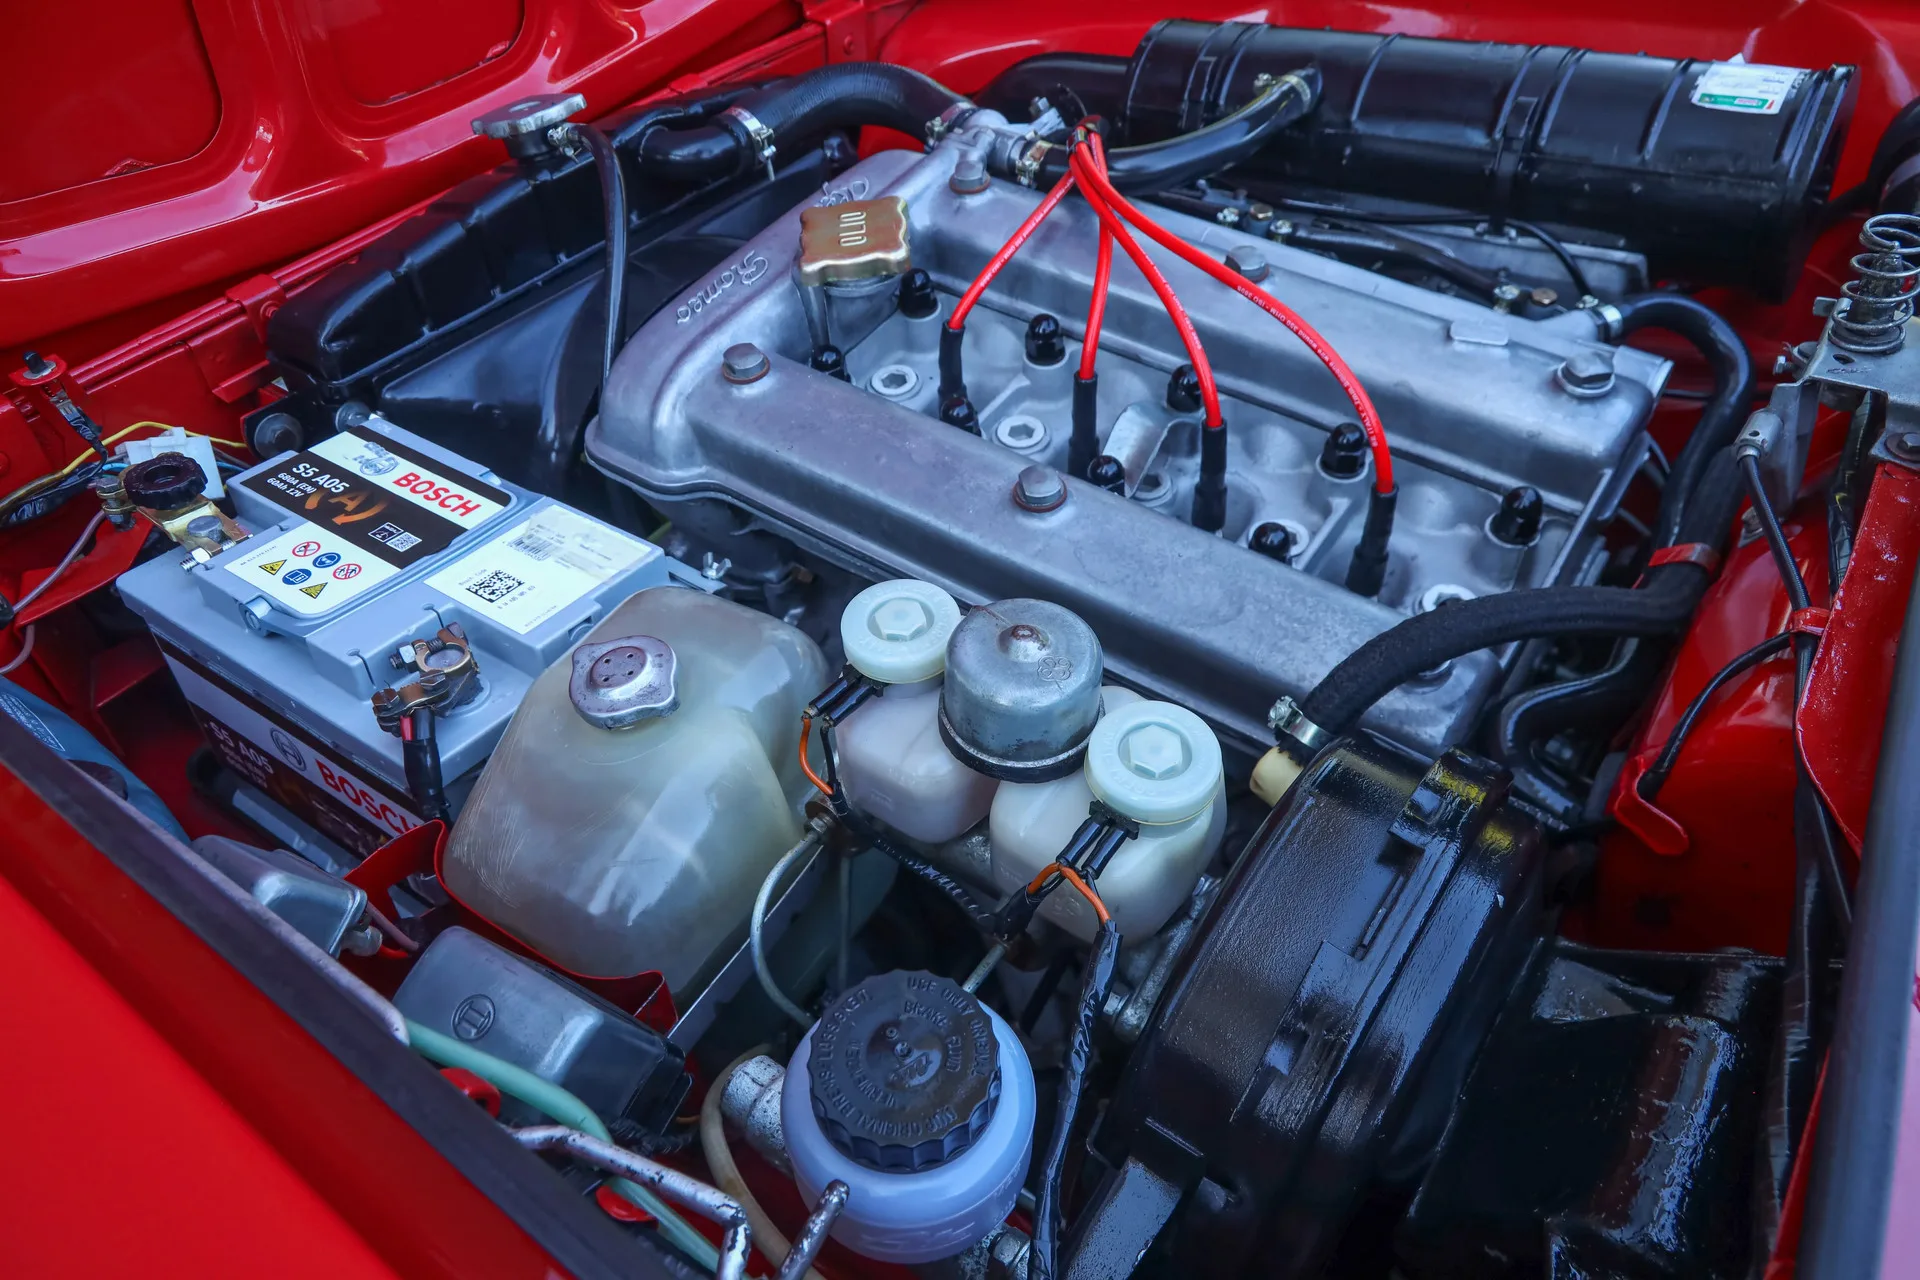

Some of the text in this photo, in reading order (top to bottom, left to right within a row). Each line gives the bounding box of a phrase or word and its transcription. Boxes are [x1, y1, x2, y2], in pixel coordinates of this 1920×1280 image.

[677, 251, 768, 325] Romeo
[1252, 295, 1266, 307] ISO
[1269, 307, 1286, 322] OHM
[266, 477, 305, 498] 60Ah 12V
[277, 472, 317, 494] 680A (EN)
[292, 462, 351, 493] S5 A05
[392, 471, 482, 517] BOSCH
[209, 721, 235, 748] S5
[239, 740, 274, 774] A05
[903, 1000, 948, 1031] BRAKE
